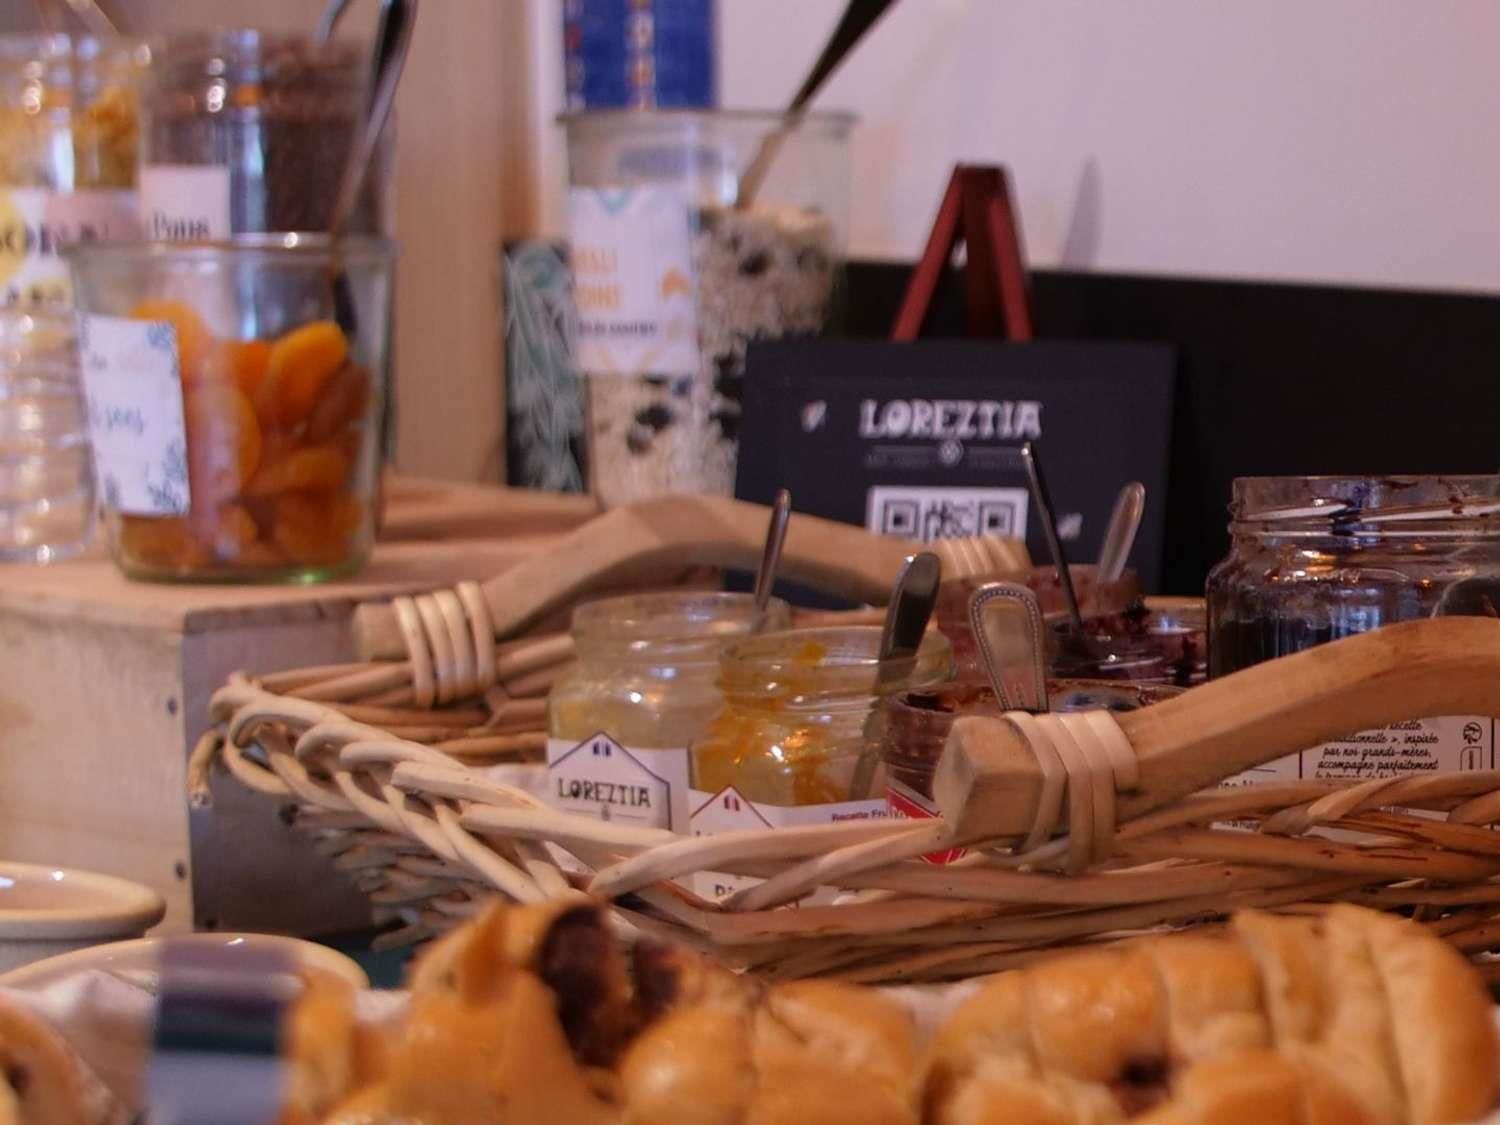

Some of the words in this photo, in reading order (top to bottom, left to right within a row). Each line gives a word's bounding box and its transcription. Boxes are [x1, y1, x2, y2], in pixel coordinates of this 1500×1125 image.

[858, 398, 1043, 440] LOREZTIA
[1317, 760, 1375, 775] accompagne
[1376, 759, 1440, 774] parfaitement
[557, 777, 651, 809] LOREZTIA
